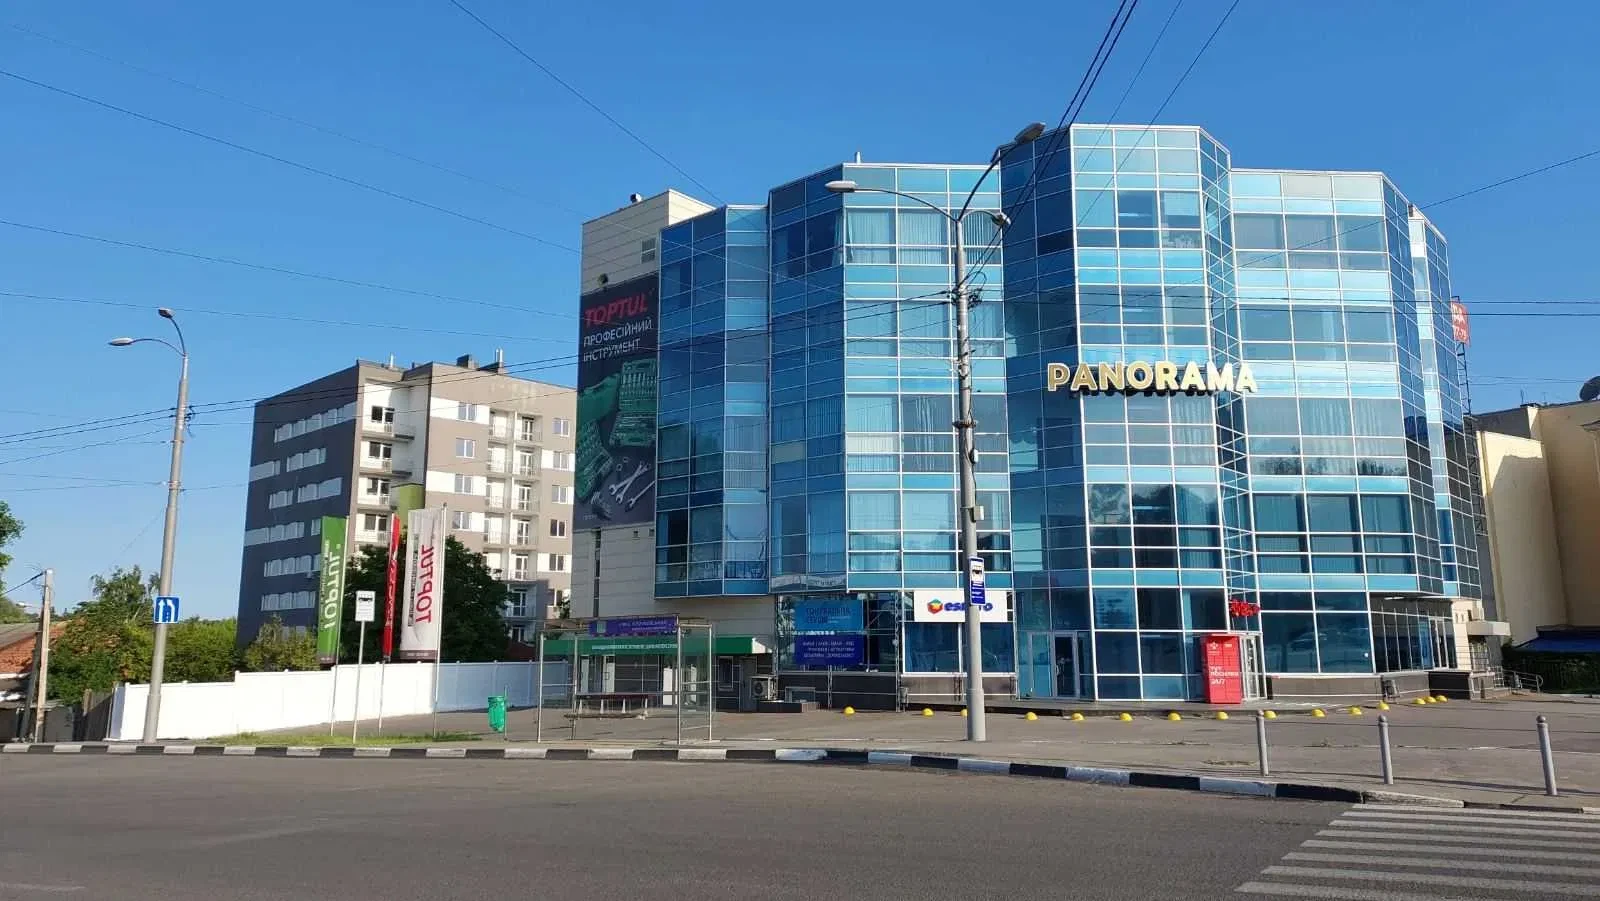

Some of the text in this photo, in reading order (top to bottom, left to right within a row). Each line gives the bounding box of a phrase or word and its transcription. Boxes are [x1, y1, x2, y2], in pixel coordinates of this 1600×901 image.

[584, 292, 648, 327] TOPTUL
[583, 316, 653, 348] ПРОФЕСІЙНИЙ
[583, 338, 641, 361] ІНСТРУМЕНТ
[1047, 360, 1257, 393] PANORAMA
